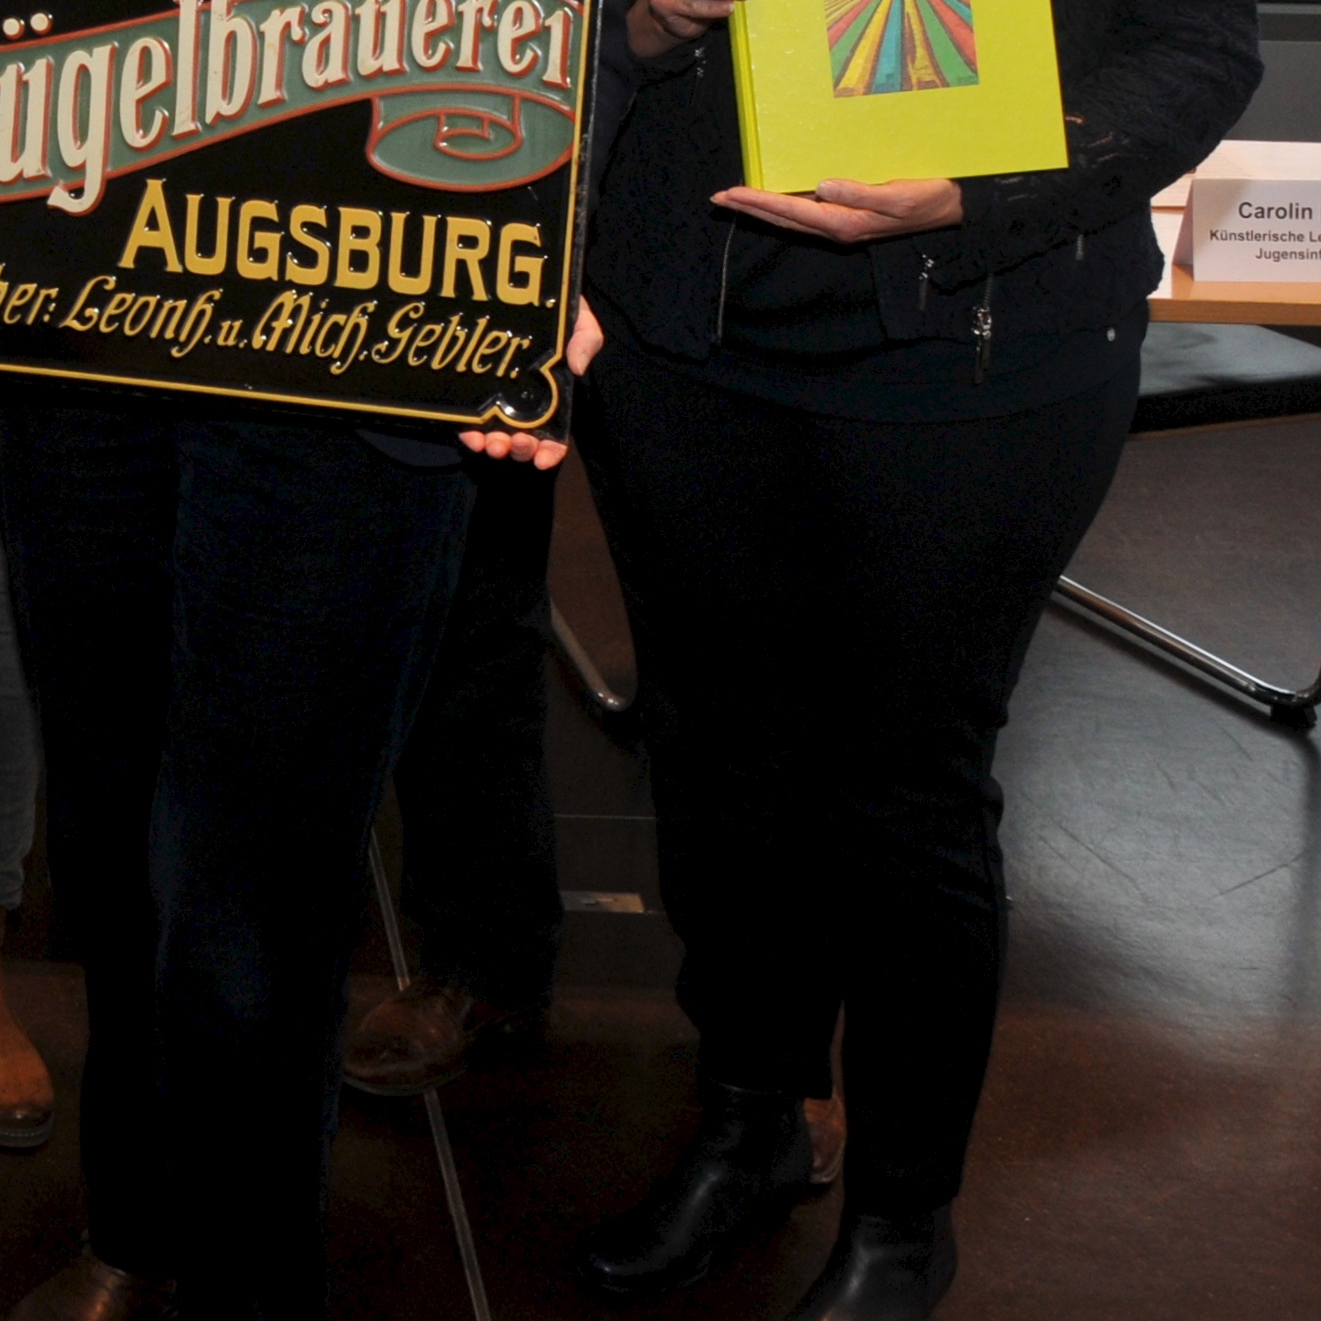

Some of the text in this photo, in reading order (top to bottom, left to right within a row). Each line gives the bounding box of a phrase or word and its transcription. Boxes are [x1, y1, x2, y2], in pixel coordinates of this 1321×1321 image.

[1238, 201, 1313, 220] Carolin
[1209, 229, 1305, 242] Künstlerische
[61, 275, 215, 358] Leonh.
[216, 318, 249, 349] u.
[251, 289, 379, 376] Mich.
